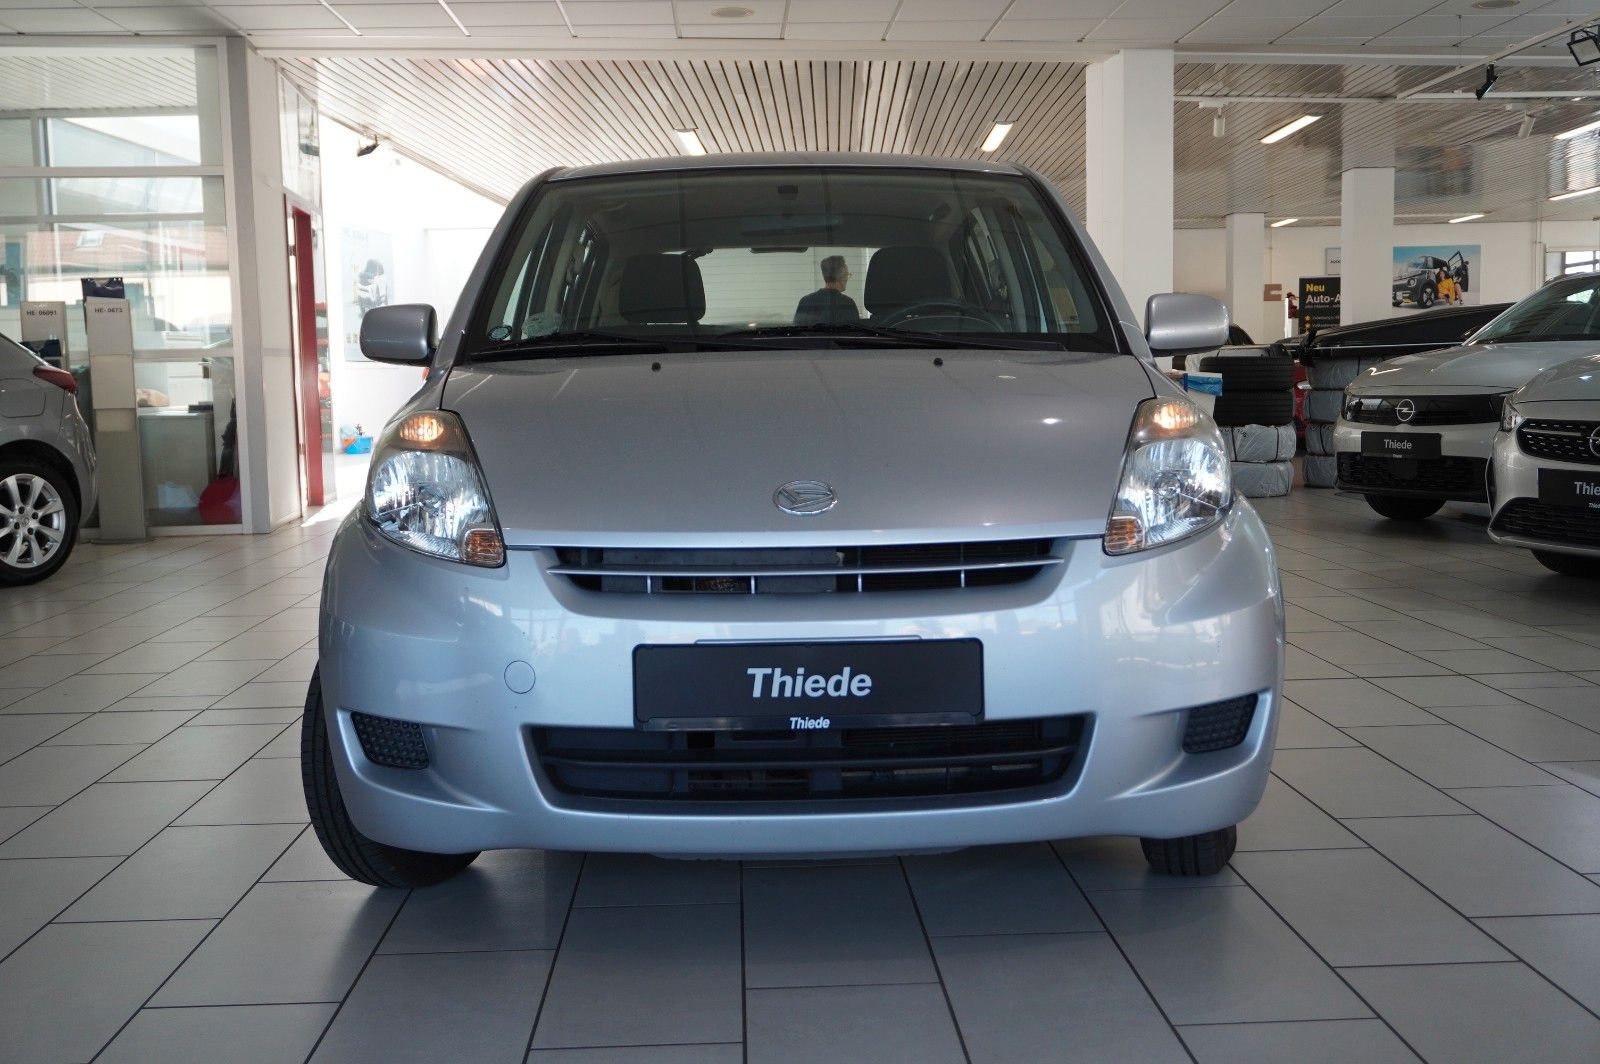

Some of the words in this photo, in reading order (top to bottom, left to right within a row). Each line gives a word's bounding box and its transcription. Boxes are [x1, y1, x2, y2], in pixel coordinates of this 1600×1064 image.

[1306, 283, 1325, 292] Neu
[1383, 439, 1412, 449] Thiede
[747, 666, 872, 698] Thiede
[789, 717, 830, 730] Thiede
